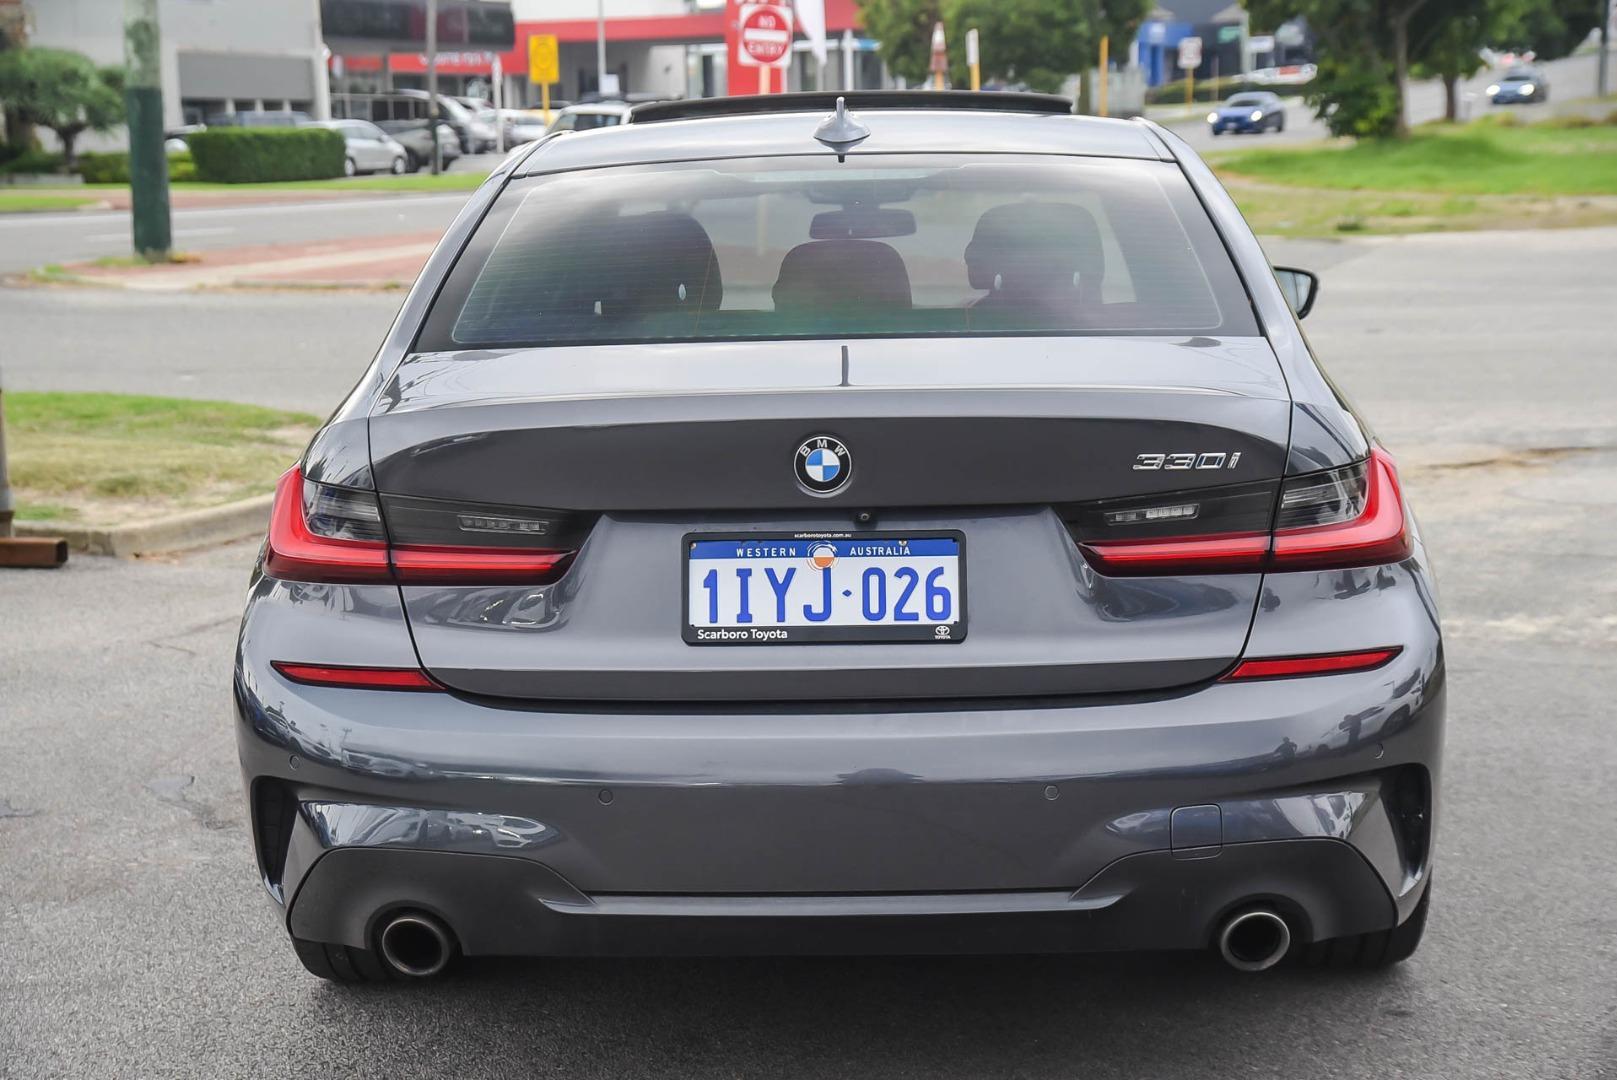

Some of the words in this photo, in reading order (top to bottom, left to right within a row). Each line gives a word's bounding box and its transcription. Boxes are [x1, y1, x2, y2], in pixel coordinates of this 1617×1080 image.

[758, 15, 777, 30] NO
[748, 41, 785, 56] ENTRY
[800, 439, 846, 457] BMW
[1133, 452, 1242, 470] 330i
[736, 547, 796, 557] WESTERN
[850, 546, 911, 556] AUSTRALIA
[697, 629, 748, 640] Scarboro
[750, 629, 788, 641] Toyota
